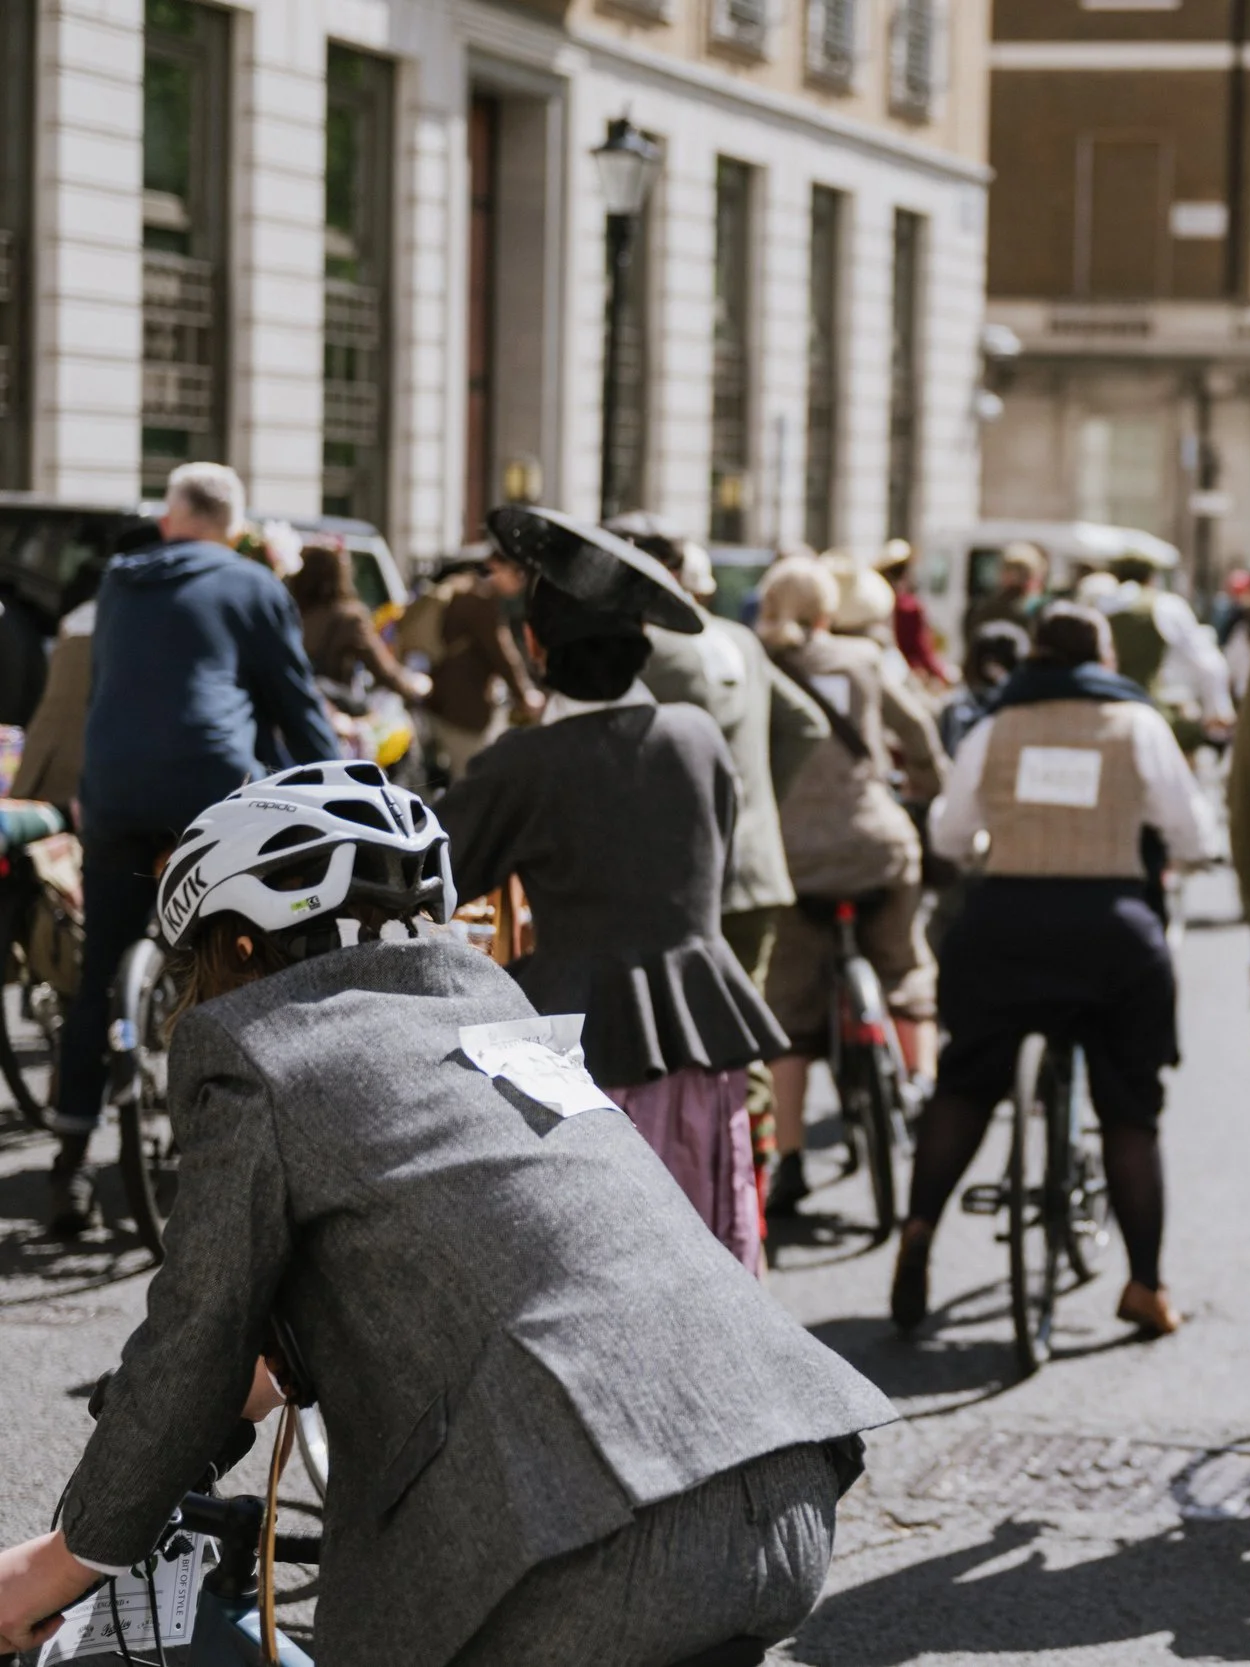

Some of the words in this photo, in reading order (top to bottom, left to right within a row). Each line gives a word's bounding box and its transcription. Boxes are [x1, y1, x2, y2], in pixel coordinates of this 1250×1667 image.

[249, 800, 298, 812] rapido
[181, 1559, 190, 1573] BIT
[179, 1574, 188, 1587] OF
[175, 1589, 187, 1616] STYLE
